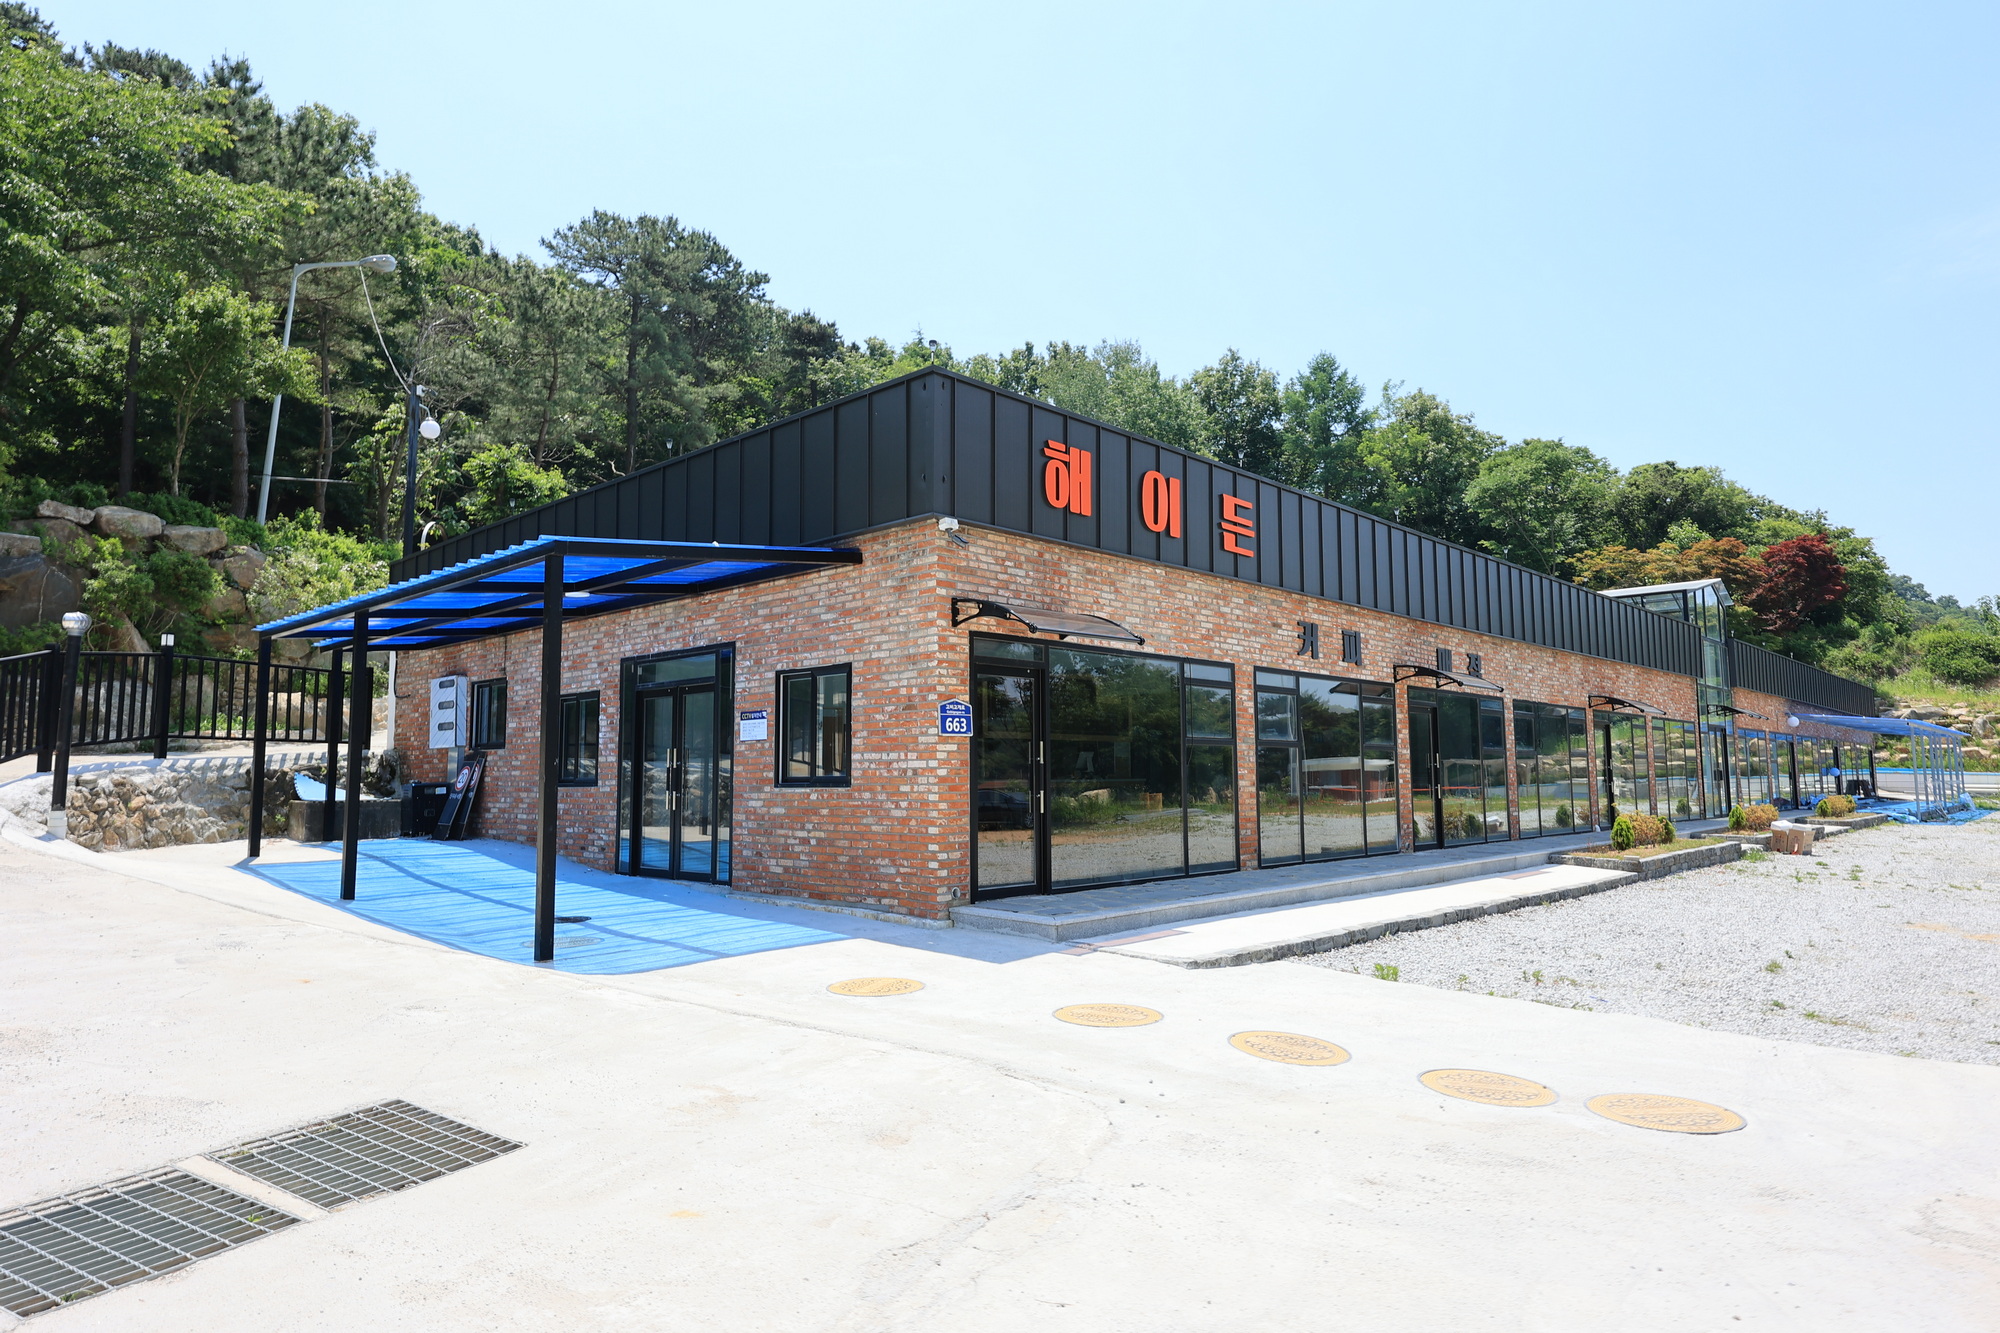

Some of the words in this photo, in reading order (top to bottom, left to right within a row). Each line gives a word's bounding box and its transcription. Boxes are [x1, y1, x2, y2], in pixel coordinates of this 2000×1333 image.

[1043, 439, 1256, 558] 해이든
[1297, 621, 1362, 666] 커피
[945, 717, 967, 732] 663
